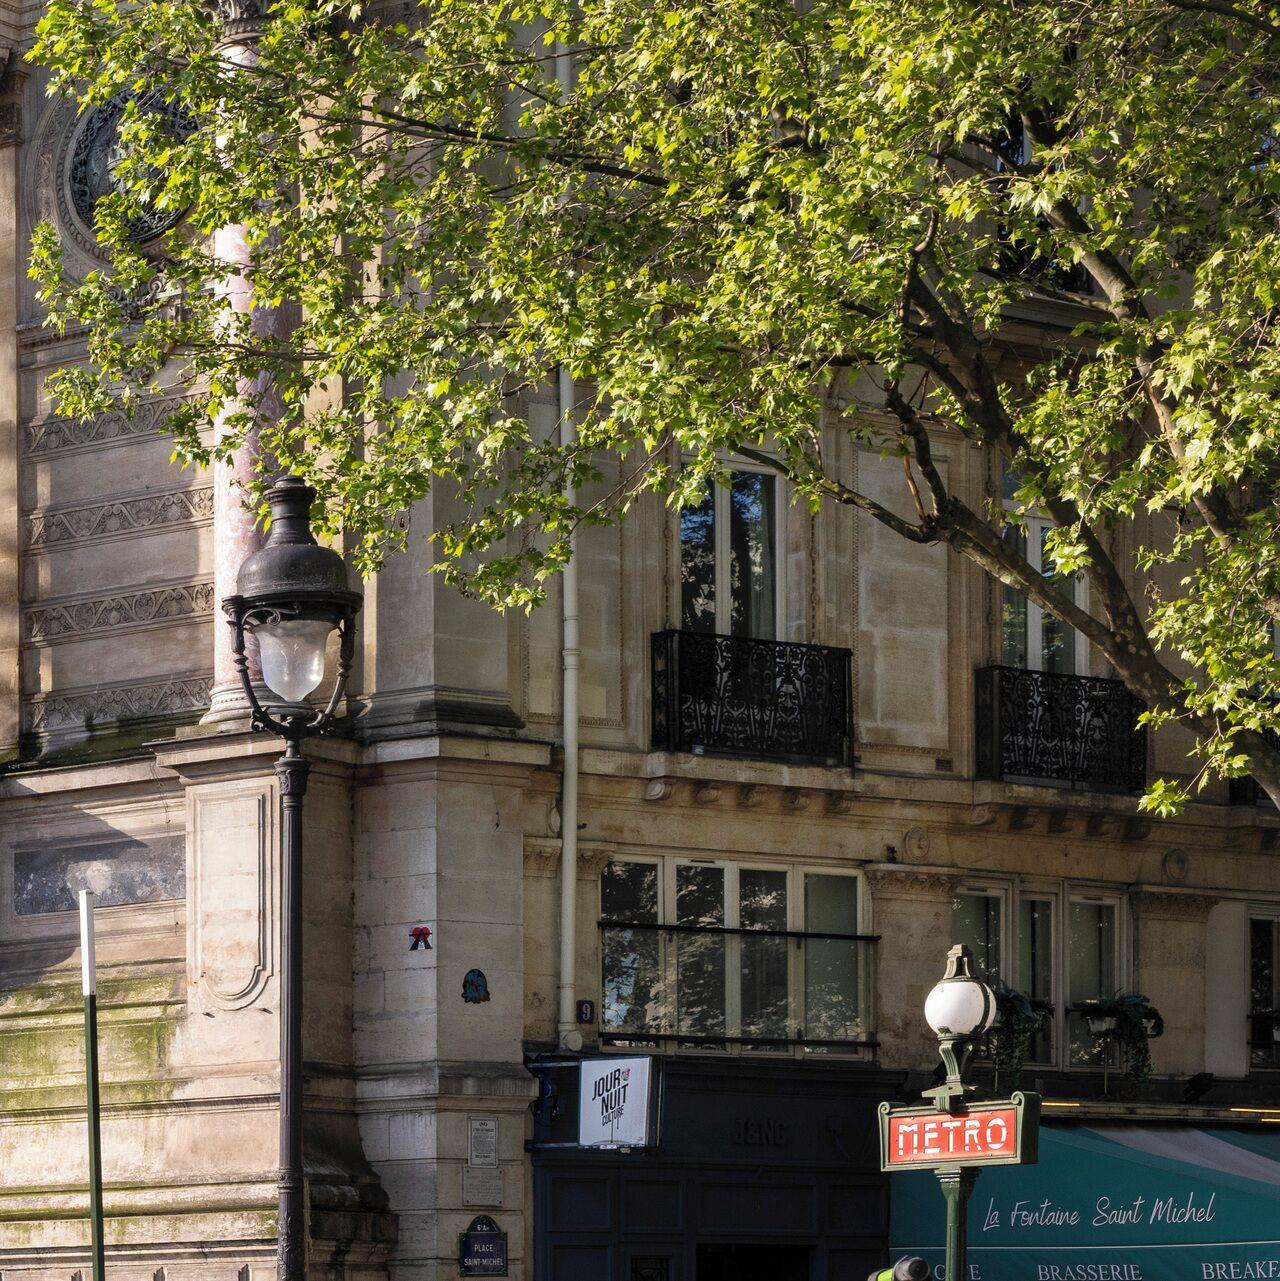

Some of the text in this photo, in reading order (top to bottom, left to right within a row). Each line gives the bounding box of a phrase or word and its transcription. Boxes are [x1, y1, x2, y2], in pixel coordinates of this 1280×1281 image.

[592, 1068, 621, 1101] JOUR
[601, 1083, 628, 1116] NUIT
[602, 1105, 624, 1126] CULTURE
[898, 1118, 1007, 1155] METRO
[983, 1192, 1216, 1232] La Fontaine Saint Michel
[474, 1244, 493, 1252] PLACE
[464, 1258, 504, 1266] SAINT-MICHEL
[934, 1261, 1280, 1281] CE BRASSERIE BREAKF
